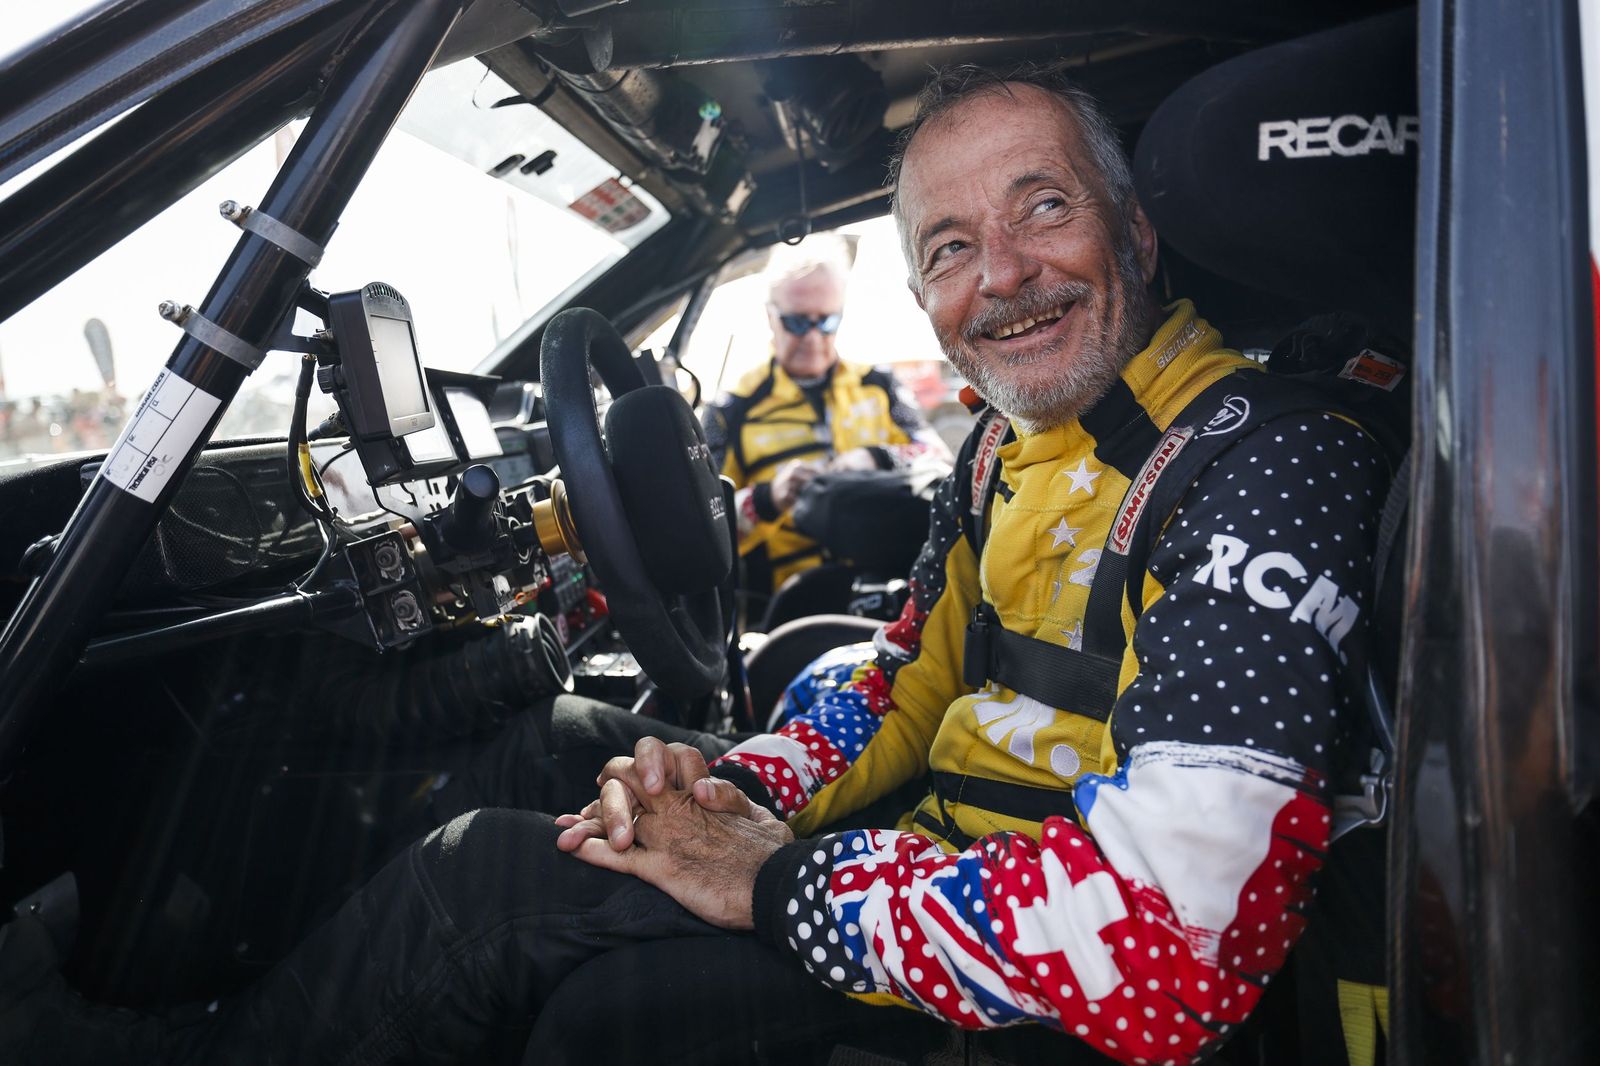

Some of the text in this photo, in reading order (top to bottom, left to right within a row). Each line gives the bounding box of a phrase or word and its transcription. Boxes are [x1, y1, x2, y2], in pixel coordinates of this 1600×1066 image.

[973, 423, 1002, 503] SIMPSON
[1117, 441, 1177, 540] SIMPSON
[1192, 533, 1360, 655] RCM
